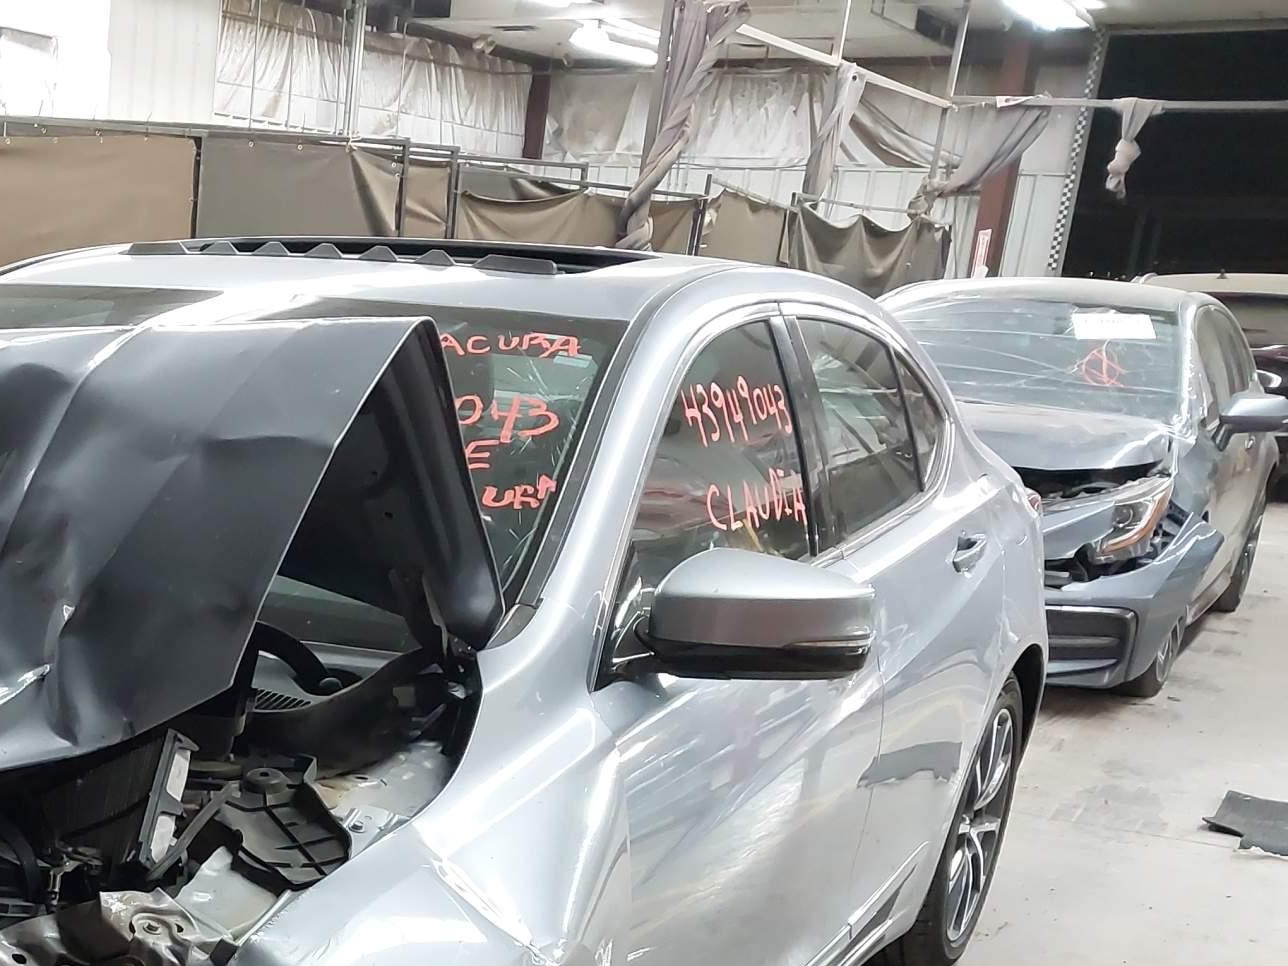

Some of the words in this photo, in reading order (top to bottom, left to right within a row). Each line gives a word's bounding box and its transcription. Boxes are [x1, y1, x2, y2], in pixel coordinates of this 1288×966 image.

[439, 332, 582, 358] ACURA
[680, 375, 793, 447] 43949043
[706, 467, 808, 531] CLAUDIA
